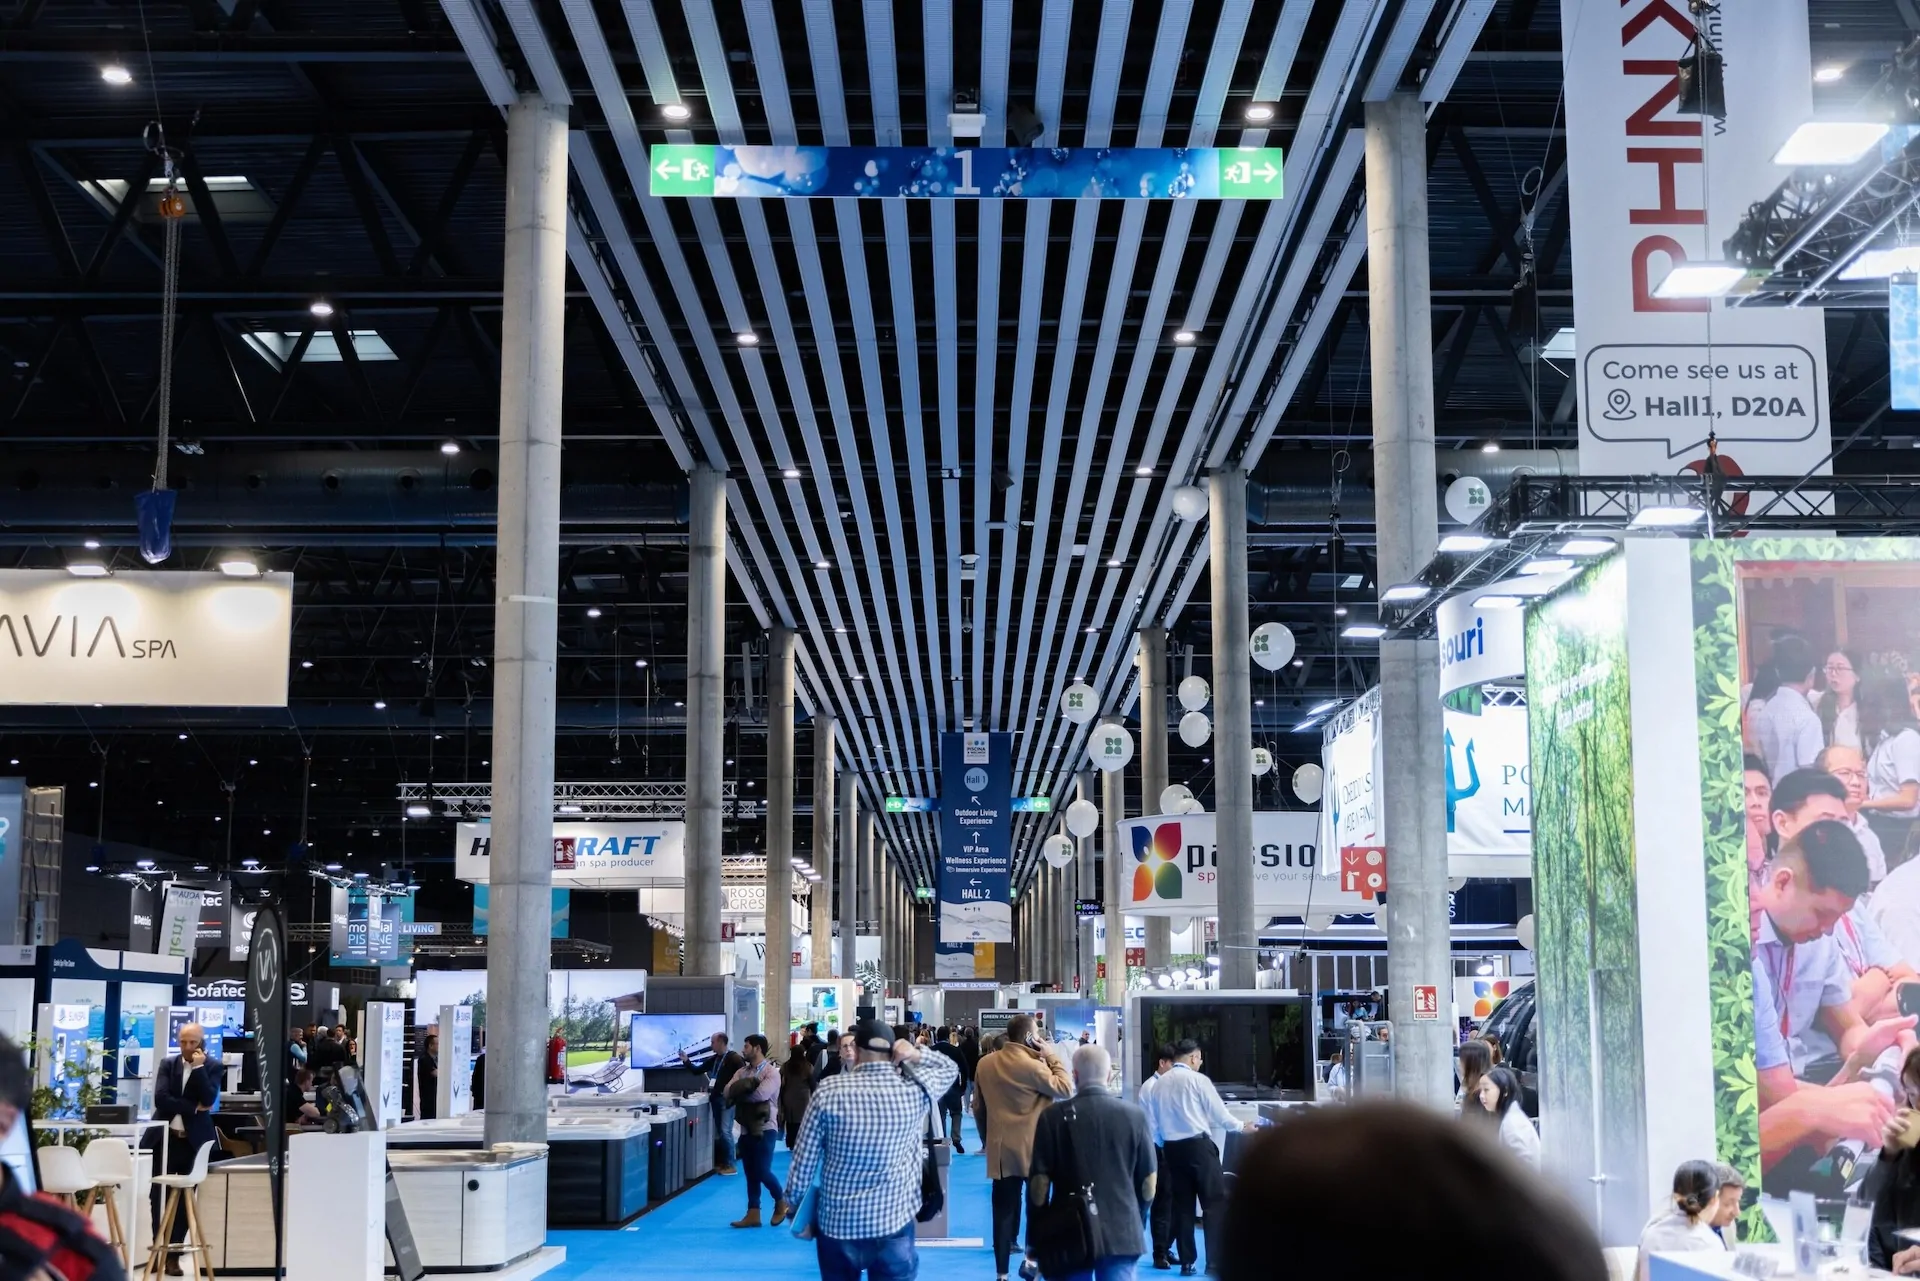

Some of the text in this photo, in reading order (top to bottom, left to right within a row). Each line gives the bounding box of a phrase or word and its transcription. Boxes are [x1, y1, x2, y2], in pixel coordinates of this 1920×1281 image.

[954, 150, 980, 194] 1
[1603, 361, 1799, 379] Come see us at
[1732, 397, 1806, 416] D20A
[132, 640, 177, 658] SPA
[966, 776, 980, 784] Hall
[980, 809, 998, 817] Living
[960, 817, 993, 825] Experience
[590, 860, 607, 868] spa
[611, 858, 654, 868] producer
[974, 857, 1006, 865] Experience
[1273, 873, 1298, 884] your
[1302, 872, 1338, 881] senses
[962, 889, 990, 899] HALL 2
[403, 925, 434, 933] LIVING
[187, 983, 246, 997] Sofatec
